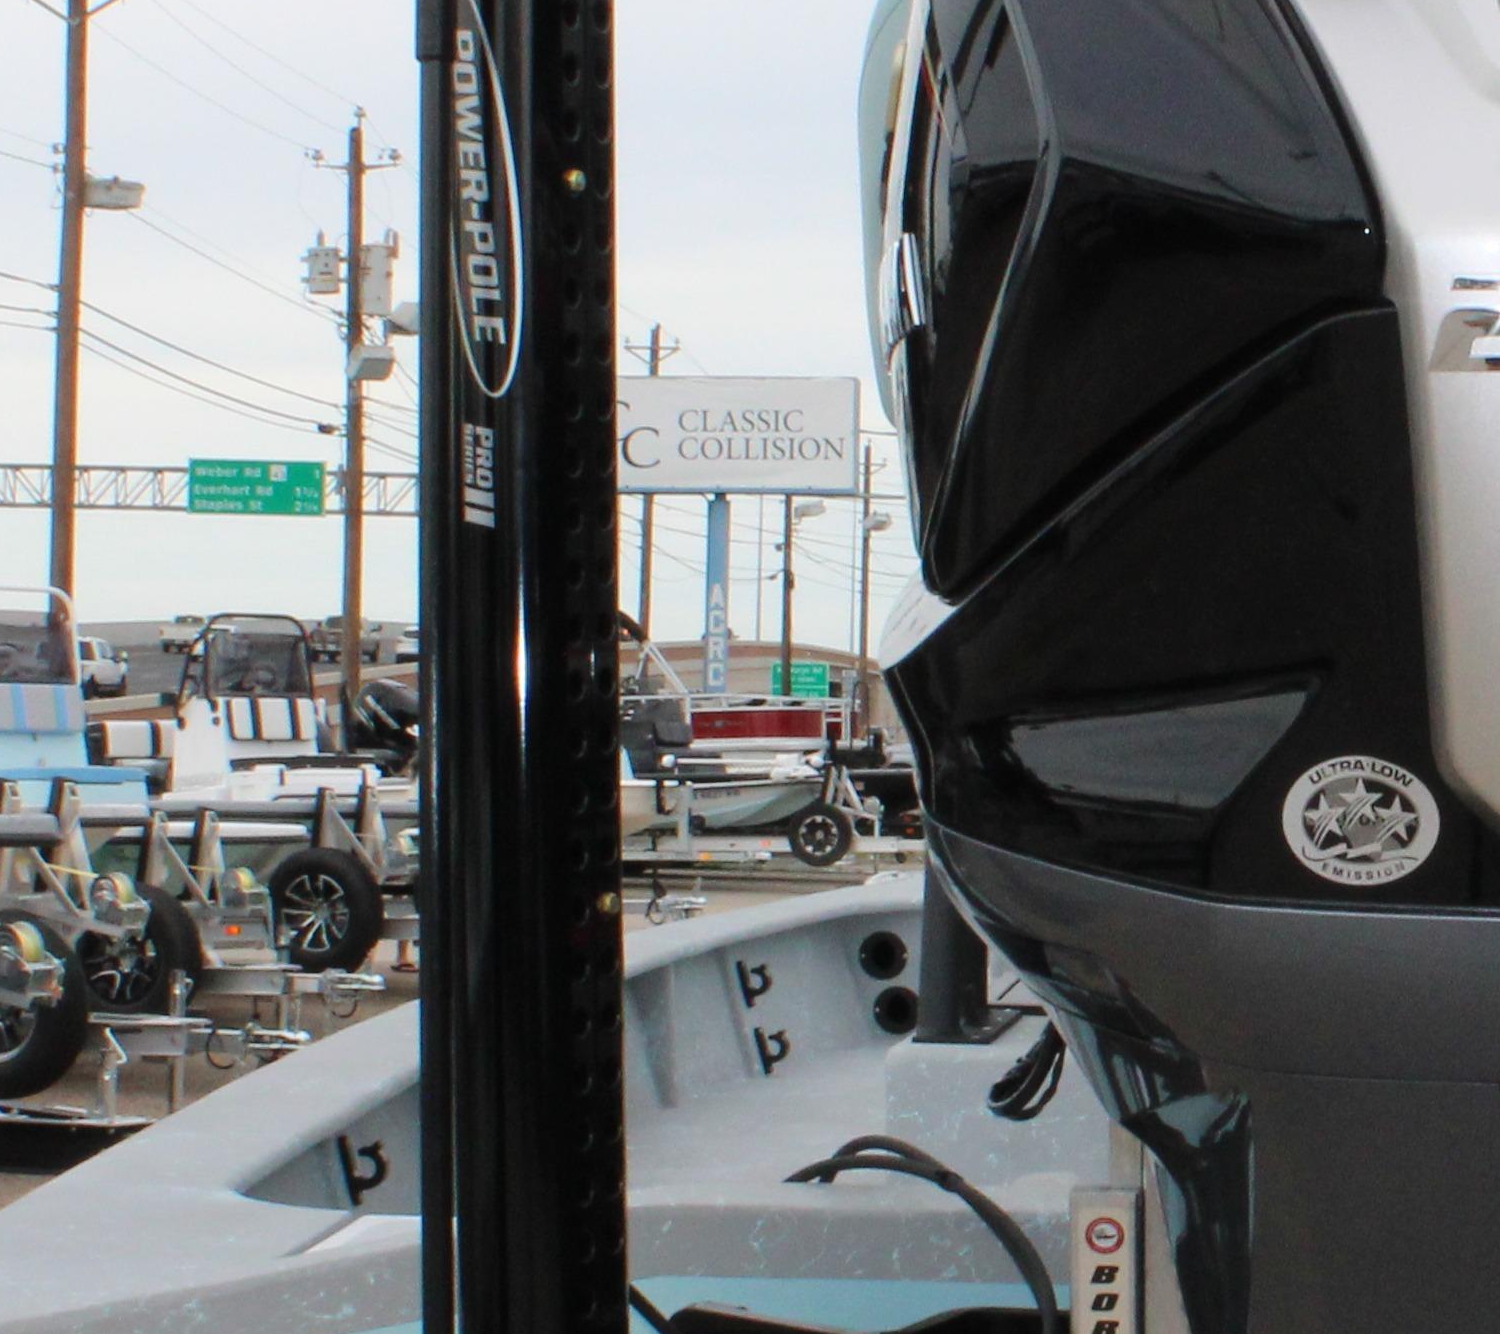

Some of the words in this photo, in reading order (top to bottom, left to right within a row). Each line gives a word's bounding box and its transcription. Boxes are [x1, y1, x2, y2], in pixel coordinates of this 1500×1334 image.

[677, 409, 804, 434] CLASSIC
[475, 425, 494, 489] PRO
[677, 435, 846, 461] COLLISION
[1321, 861, 1406, 881] EMISSION
